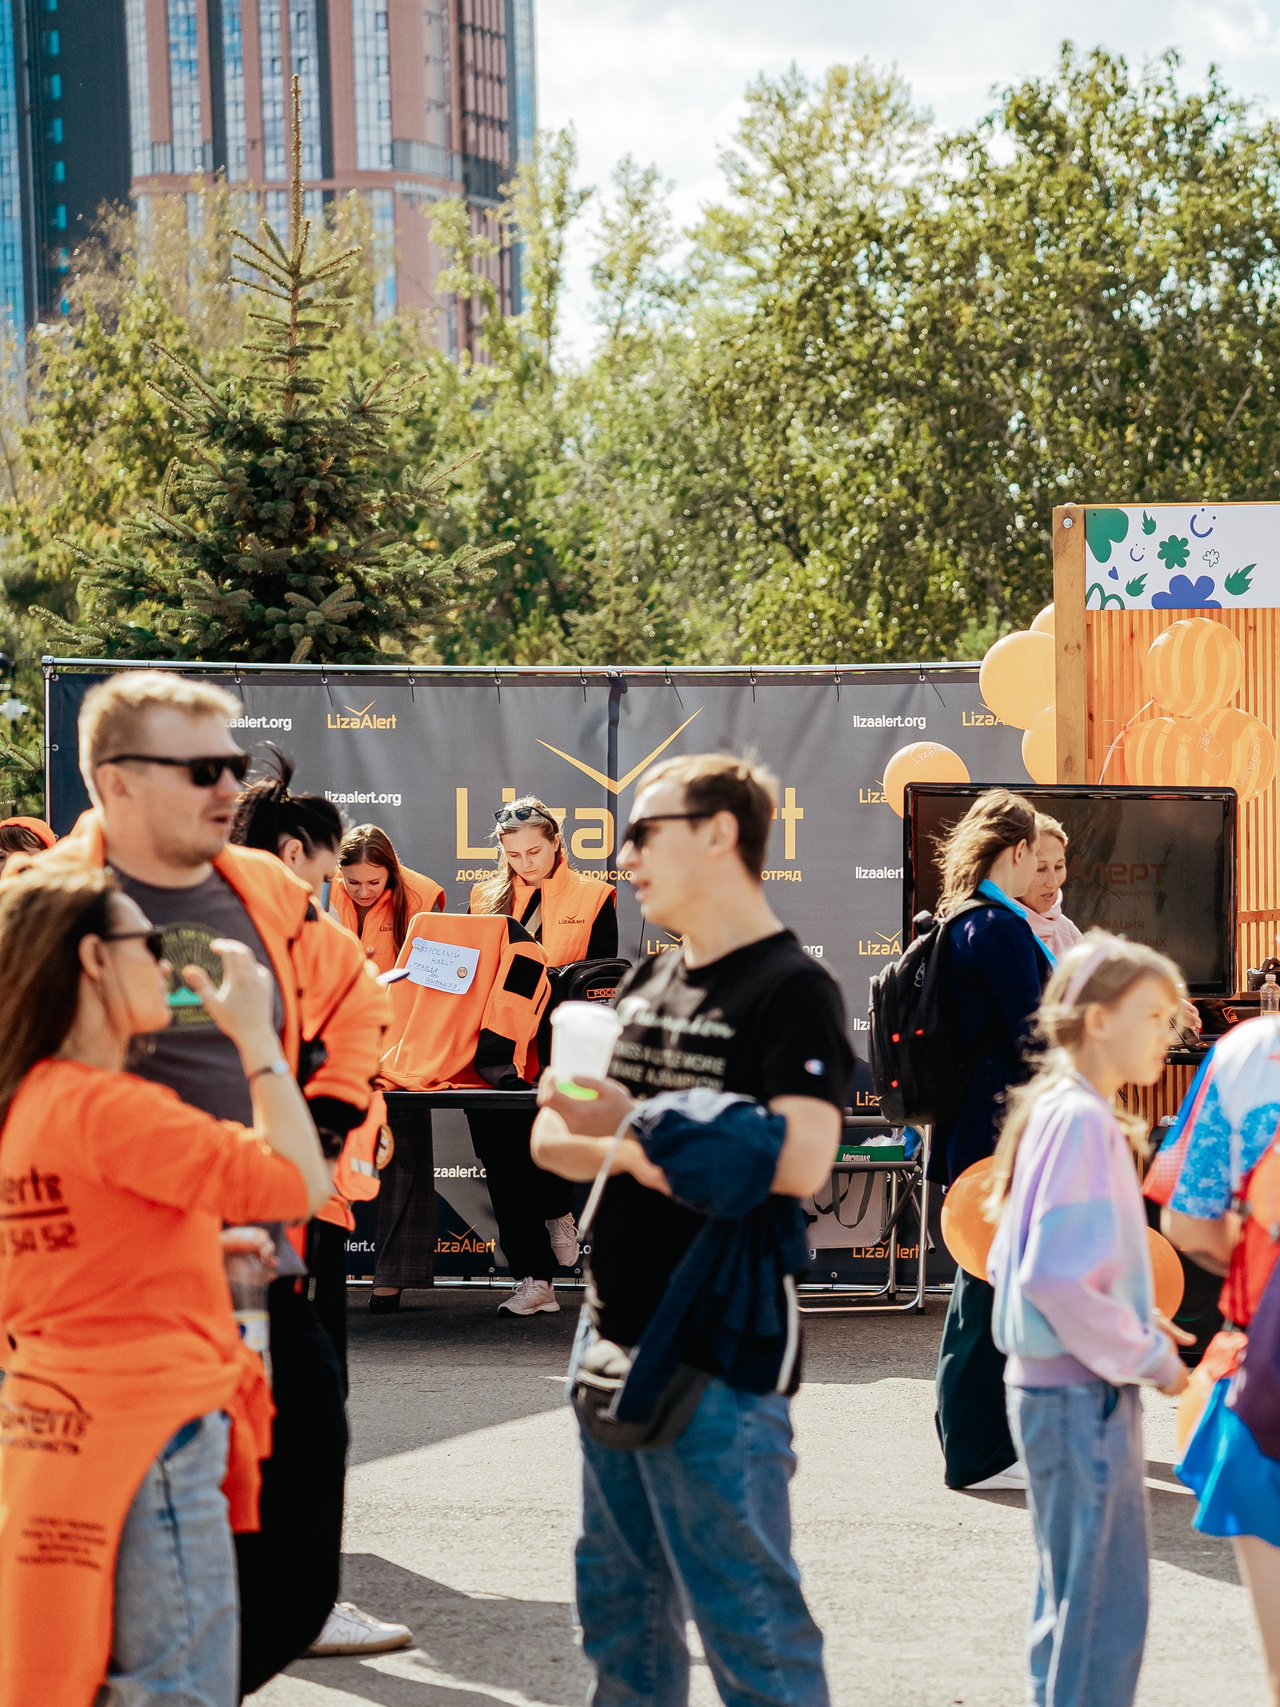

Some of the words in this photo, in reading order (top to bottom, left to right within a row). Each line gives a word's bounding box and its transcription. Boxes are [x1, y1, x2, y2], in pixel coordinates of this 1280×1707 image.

[223, 715, 293, 732] zaalert.org
[326, 713, 398, 730] LizaAlert
[853, 714, 927, 730] lizaalert.org
[962, 711, 1008, 727] LizaA
[324, 790, 402, 807] lizaalert.org
[760, 870, 802, 883] ОТРЯД
[855, 866, 904, 880] lizaalert
[858, 940, 903, 956] LizaA
[431, 957, 455, 967] КВЕСТ
[433, 1164, 487, 1178] zaalert.o
[434, 1237, 496, 1253] izaAlert
